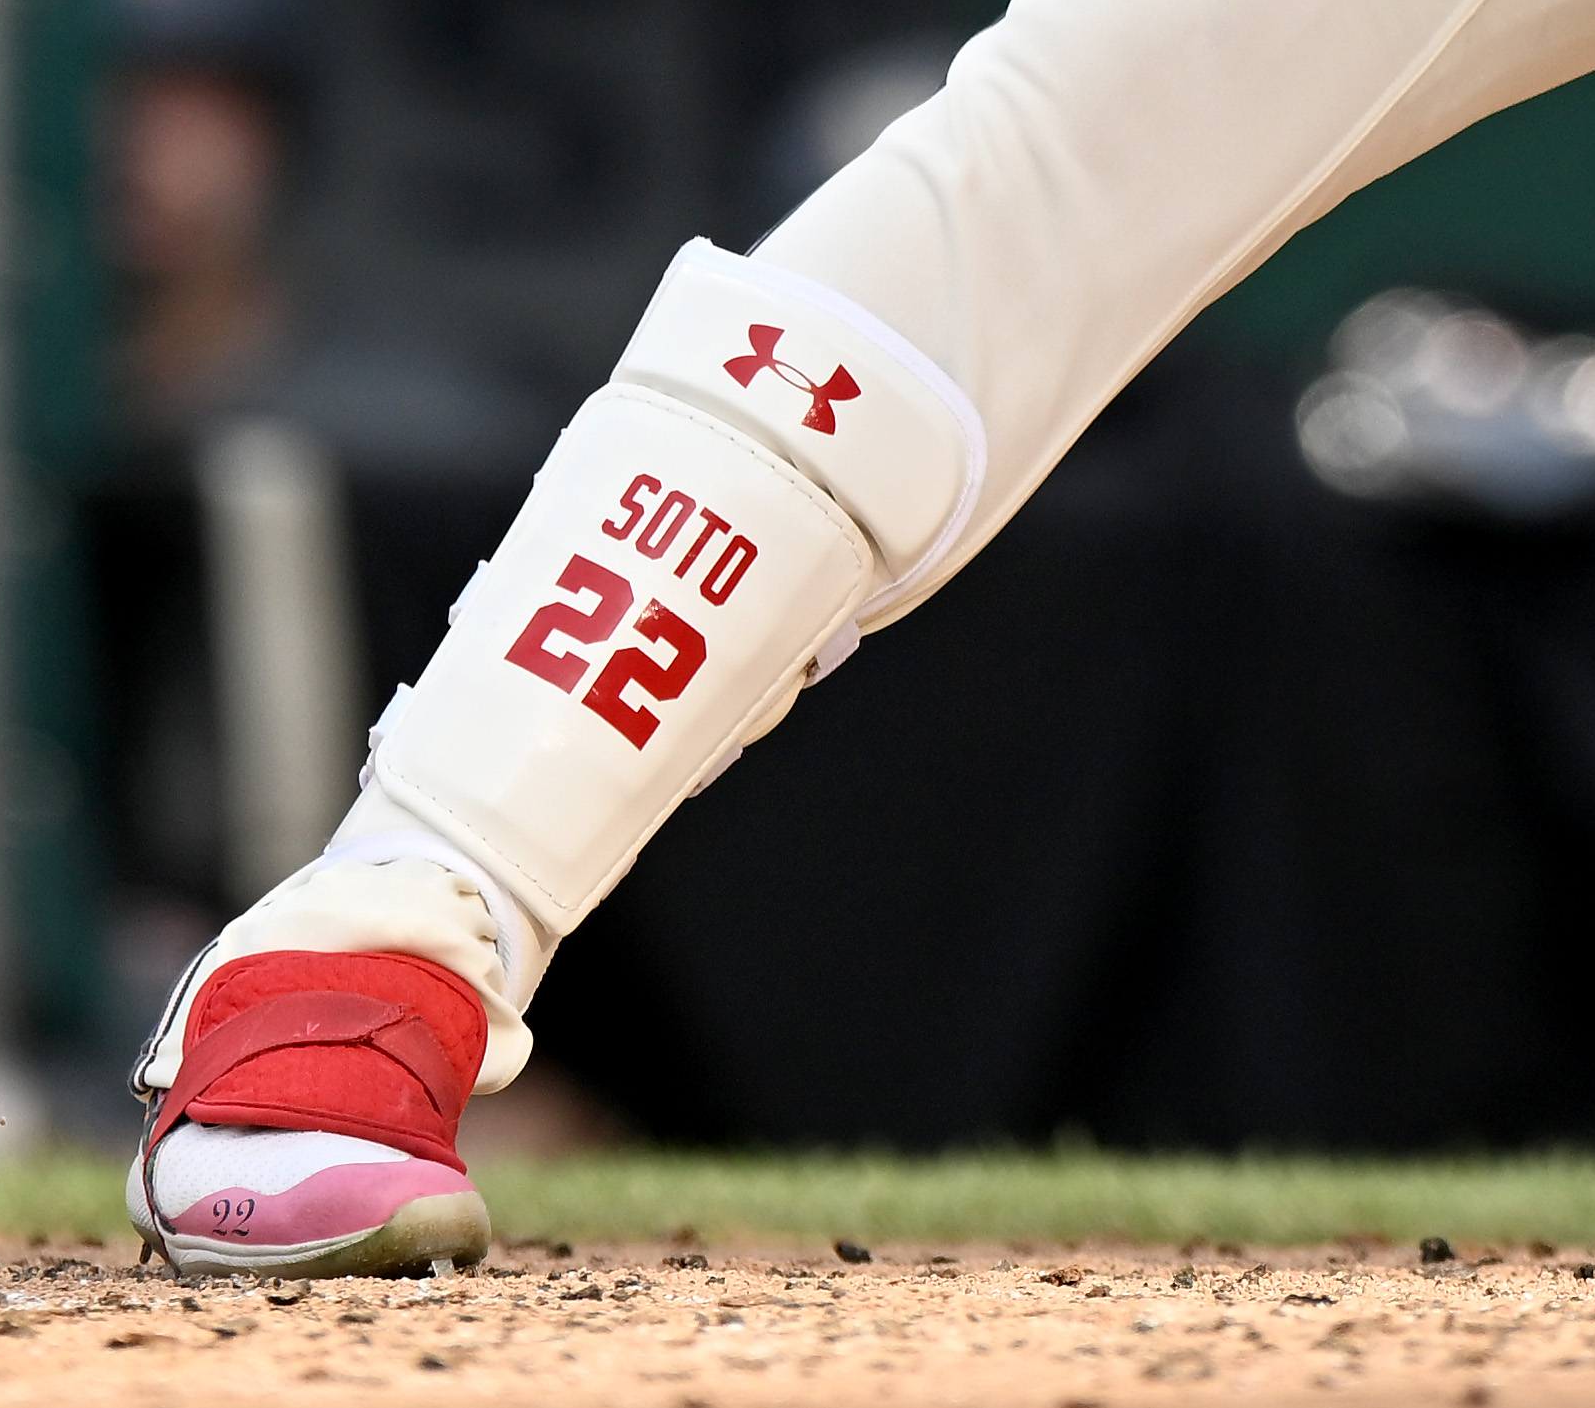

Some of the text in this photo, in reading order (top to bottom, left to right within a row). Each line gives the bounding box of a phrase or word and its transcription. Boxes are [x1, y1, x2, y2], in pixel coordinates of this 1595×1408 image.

[601, 473, 758, 607] SOTO
[504, 553, 707, 752] 22
[211, 1197, 256, 1238] 22
